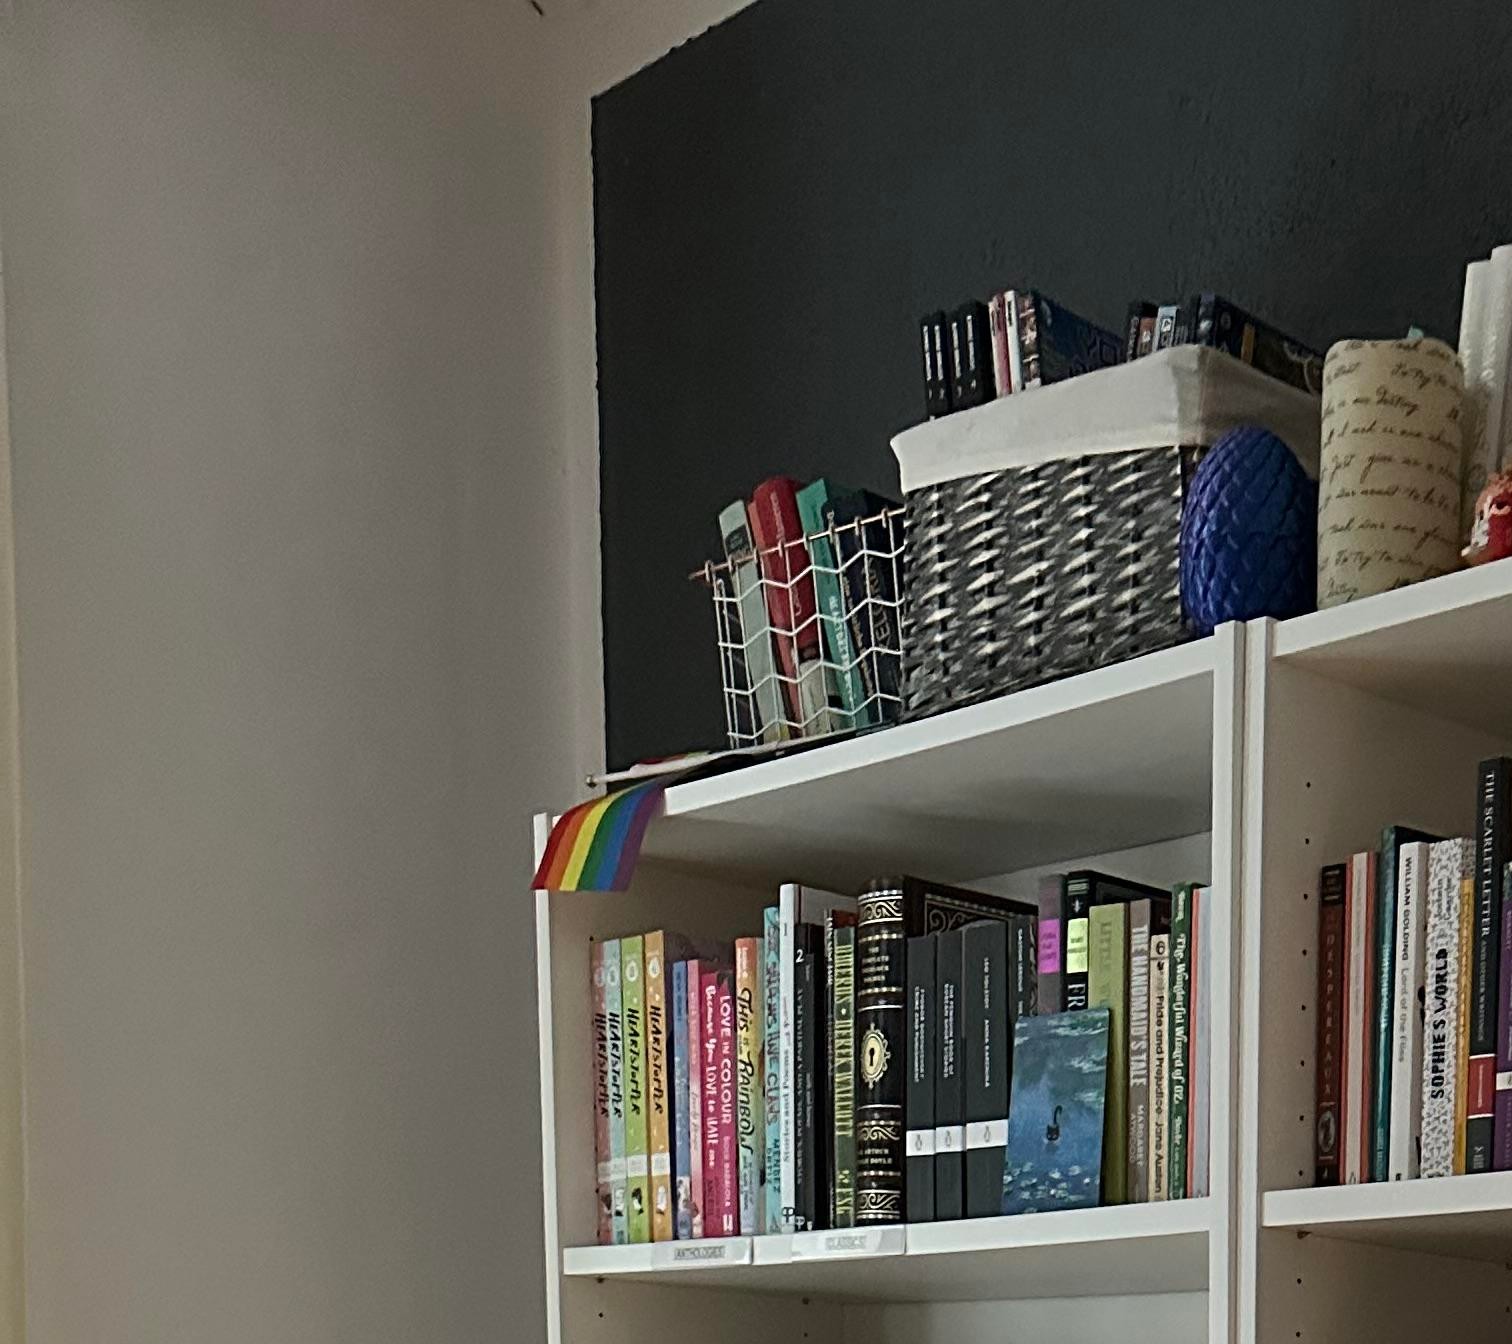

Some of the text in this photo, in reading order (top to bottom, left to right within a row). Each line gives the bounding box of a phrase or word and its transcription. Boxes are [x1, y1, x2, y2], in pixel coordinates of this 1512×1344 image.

[1400, 857, 1413, 961] WILLIAM GOLDING
[1479, 771, 1497, 938] THE SCARLET LETTER
[719, 995, 732, 1125] LOVE COLOUR
[1129, 955, 1150, 1088] HANDMAID'S TALE
